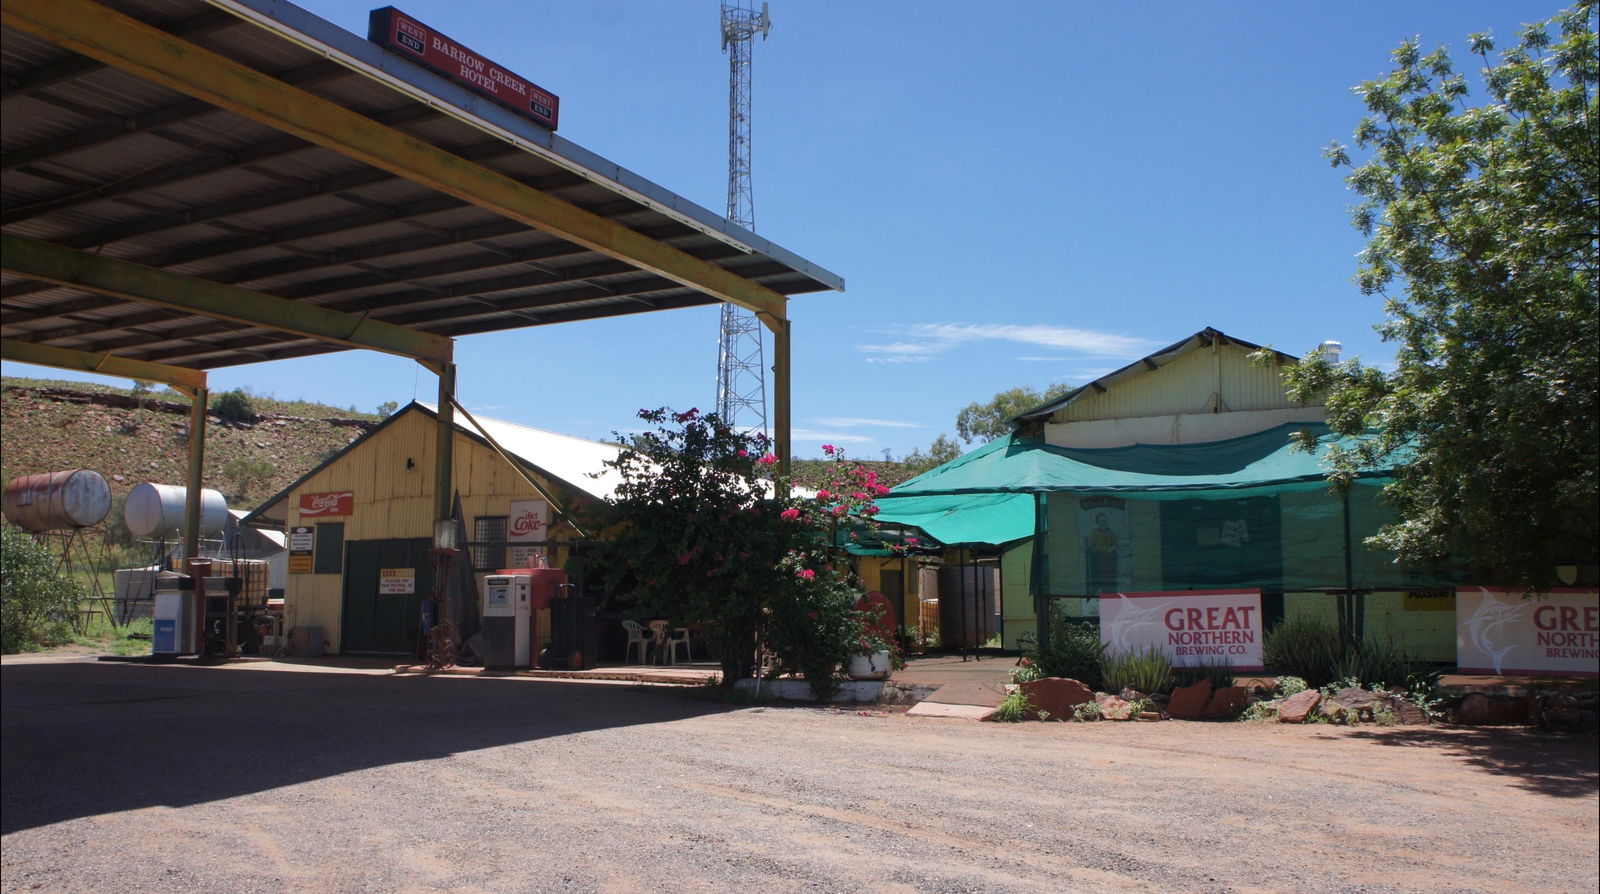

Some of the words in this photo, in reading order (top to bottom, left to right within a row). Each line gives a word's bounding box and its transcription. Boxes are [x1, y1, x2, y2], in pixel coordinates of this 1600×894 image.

[400, 21, 424, 40] WEST
[402, 36, 420, 50] END
[432, 36, 485, 73] BARROW
[489, 67, 526, 96] CREEK
[460, 65, 498, 94] HOTEL
[532, 93, 551, 108] WEST
[534, 104, 549, 117] END
[525, 511, 538, 520] diet
[514, 516, 547, 531] Coke
[1164, 606, 1255, 631] GREAT
[1533, 605, 1599, 631] GRE
[1168, 630, 1254, 645] NORTHERN
[1176, 645, 1224, 656] BREWING
[1228, 645, 1248, 655] CO.
